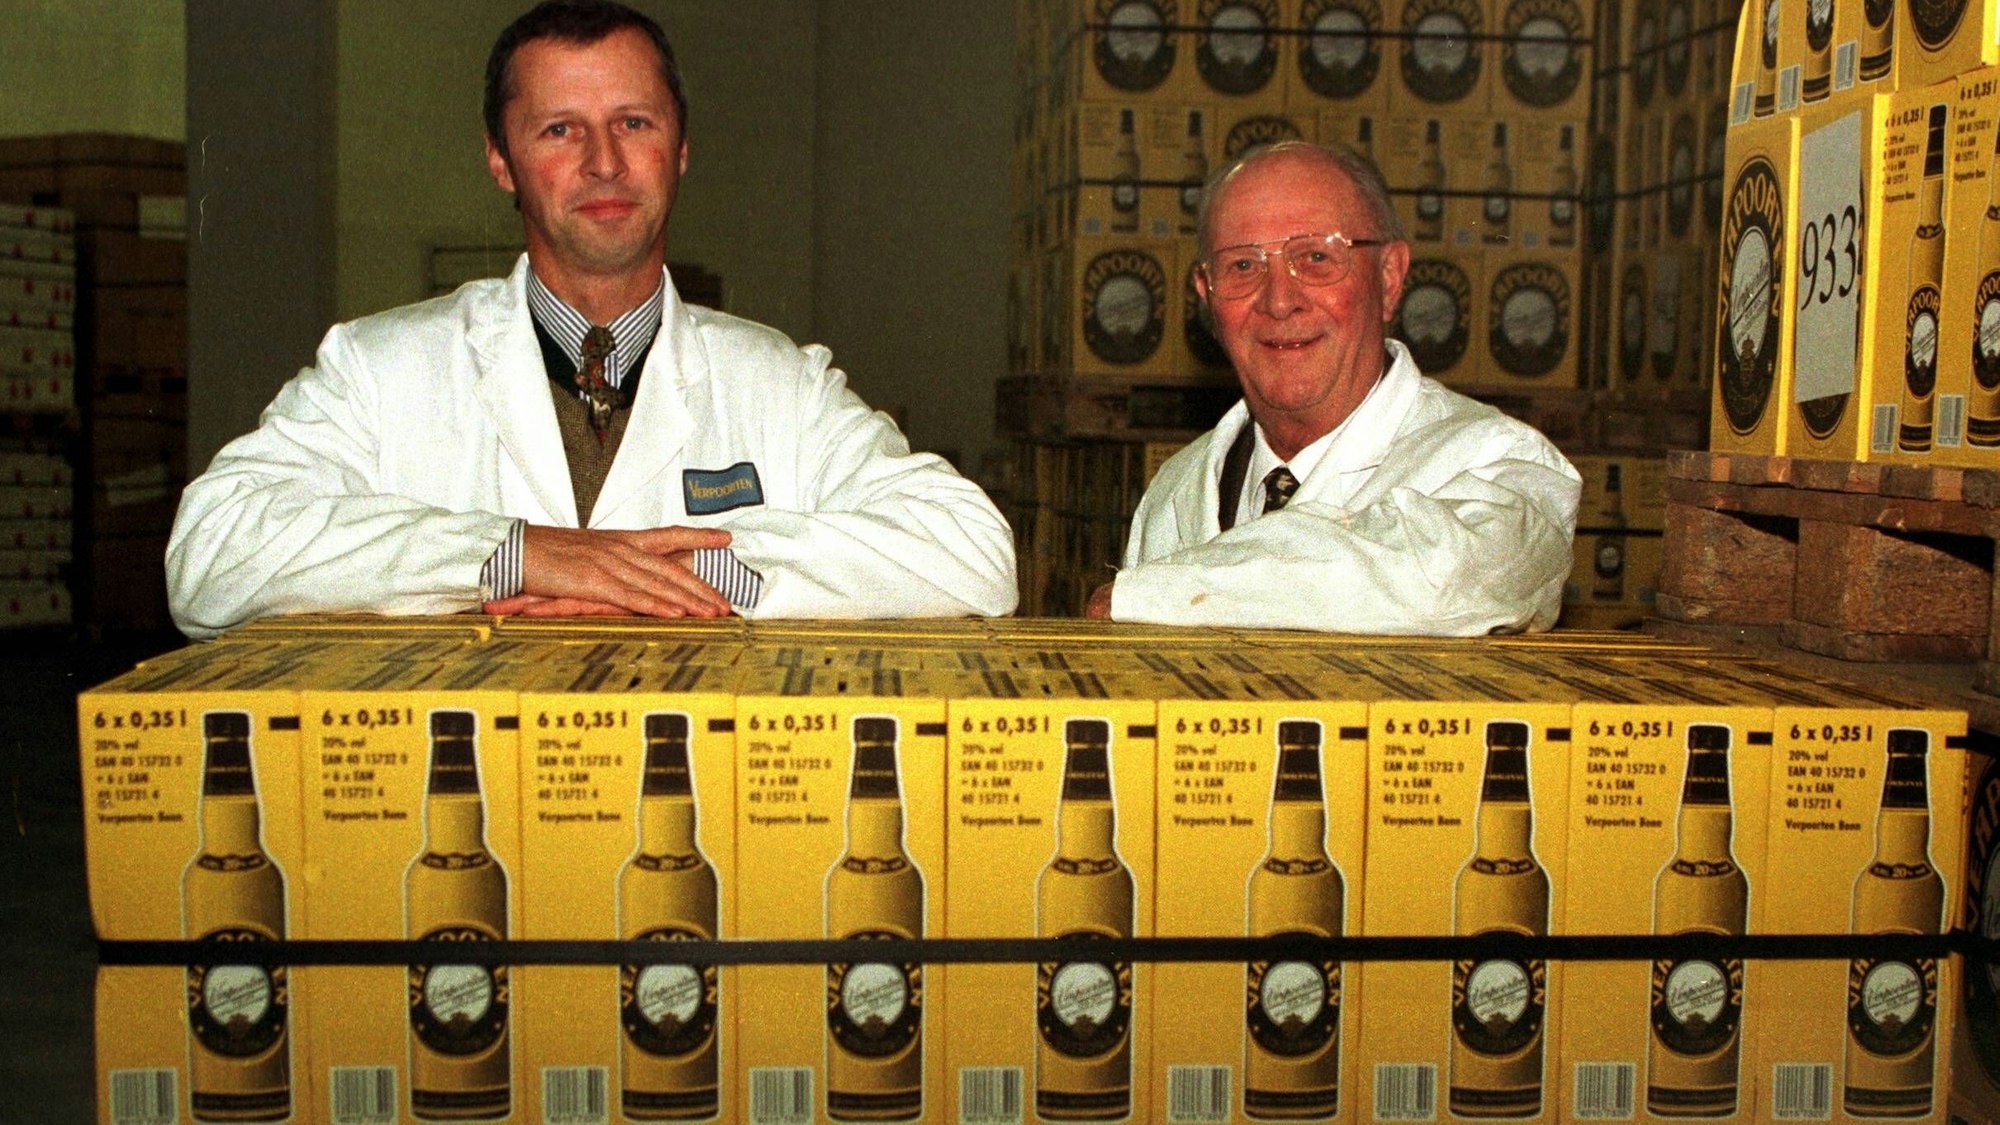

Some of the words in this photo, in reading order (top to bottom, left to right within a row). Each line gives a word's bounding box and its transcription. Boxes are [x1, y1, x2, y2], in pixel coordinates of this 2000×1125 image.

[1801, 203, 1858, 312] 933
[93, 712, 107, 728] 6
[113, 716, 124, 728] x
[129, 710, 175, 730] 0,35
[179, 709, 187, 727] l
[321, 710, 334, 726] 6
[339, 714, 351, 726] x
[356, 709, 400, 729] 0,35
[406, 708, 413, 724] l
[536, 712, 550, 728] 6
[556, 716, 566, 727] x
[572, 711, 615, 730] 0,35
[621, 711, 627, 727] l
[749, 716, 760, 730] 6
[767, 720, 777, 730] x
[783, 715, 825, 733] 0,35
[831, 715, 837, 729] l
[962, 718, 974, 732] 6
[980, 722, 990, 732] x
[996, 717, 1038, 735] 0,35
[1043, 717, 1049, 732] l
[1175, 718, 1187, 733] 6
[1193, 723, 1203, 733] x
[1209, 718, 1251, 736] 0,35
[1256, 718, 1263, 733] l
[1384, 719, 1396, 734] 6
[1402, 723, 1412, 734] x
[1417, 719, 1459, 737] 0,35
[1464, 719, 1471, 734] l
[1588, 721, 1601, 736] 6
[1606, 725, 1616, 736] x
[1621, 721, 1662, 740] 0,35
[1666, 721, 1674, 737] l
[1789, 724, 1802, 740] 6
[1806, 729, 1817, 740] x
[1821, 725, 1862, 744] 0,35
[1866, 725, 1873, 742] l
